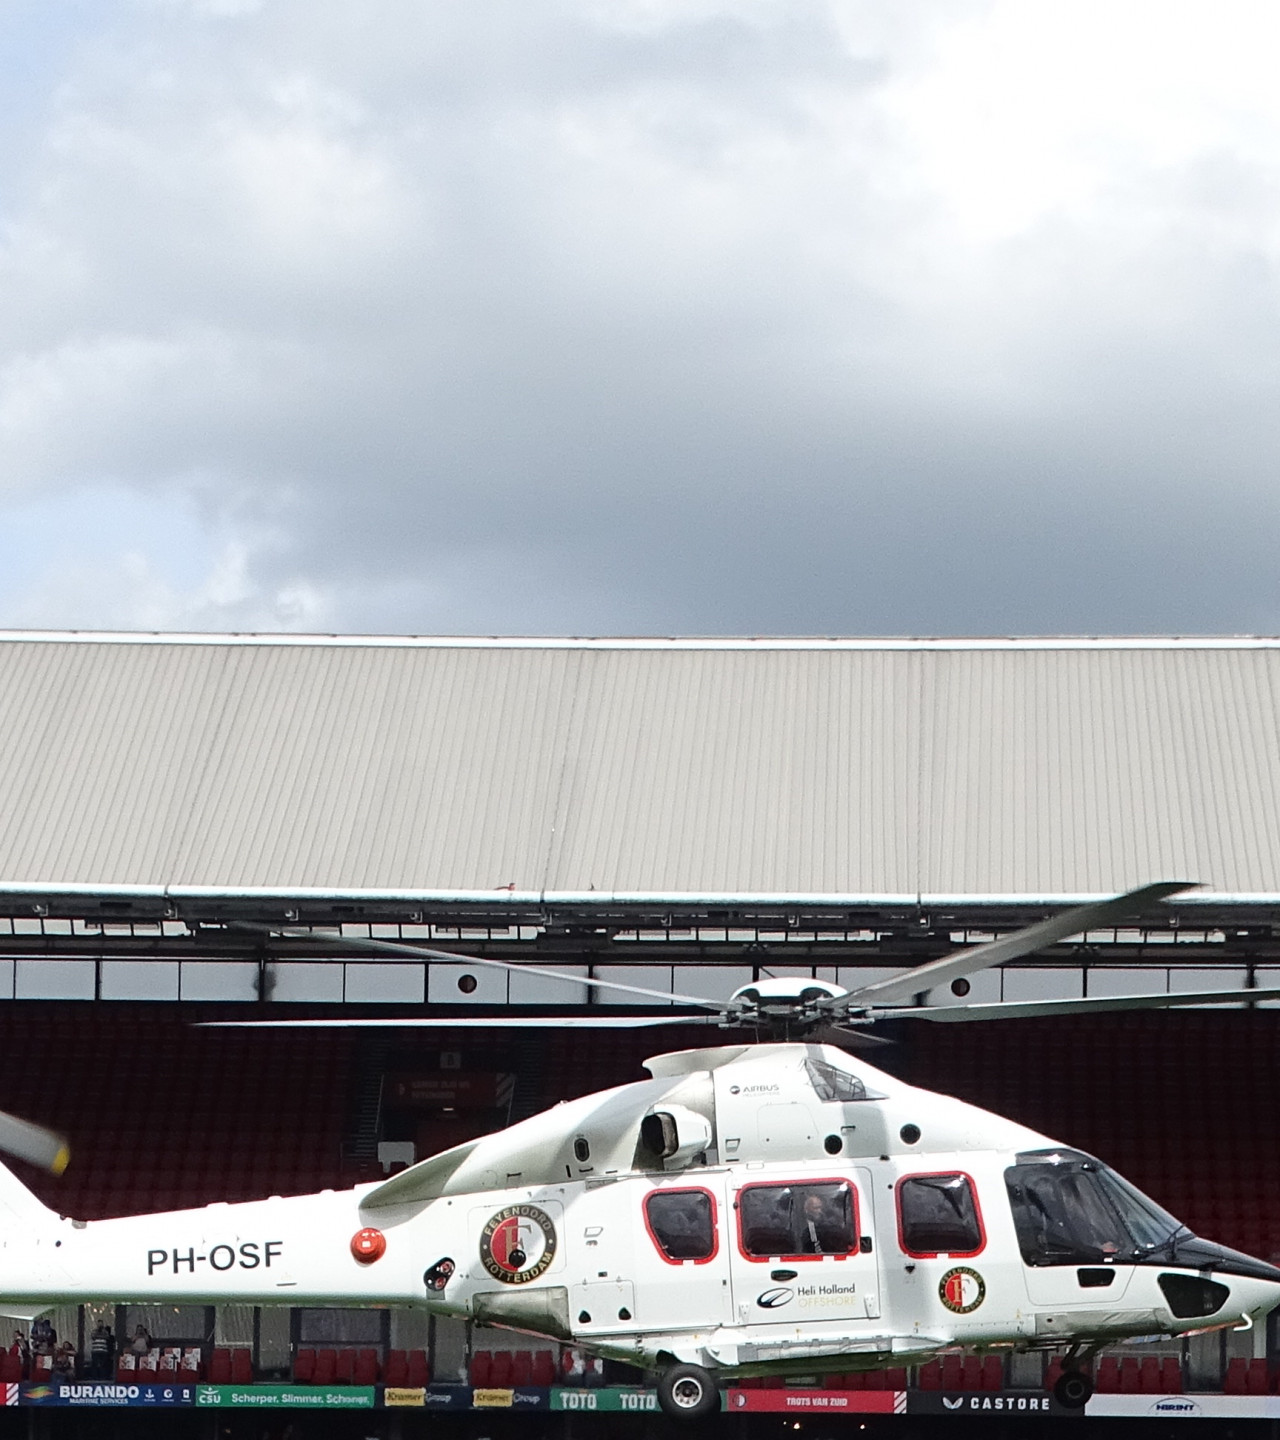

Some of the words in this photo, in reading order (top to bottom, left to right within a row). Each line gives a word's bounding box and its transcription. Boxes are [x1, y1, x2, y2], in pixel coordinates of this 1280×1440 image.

[743, 1084, 779, 1093] AIRBUS
[484, 1206, 552, 1237] FEYENOORD
[147, 1240, 283, 1276] PH-OSF
[484, 1252, 553, 1283] ROTTERDAM
[797, 1286, 815, 1297] Heli
[819, 1283, 856, 1296] Holland
[798, 1296, 856, 1308] OFFSHORE
[59, 1386, 139, 1398] BURANDO
[231, 1393, 280, 1404] Scherper.
[282, 1393, 324, 1404] Slimmer.
[199, 1394, 221, 1404] CSU
[560, 1392, 597, 1409] TOTO
[620, 1393, 657, 1409] TOTO
[786, 1397, 811, 1407] TROTS
[812, 1397, 828, 1407] VAN
[829, 1397, 848, 1407] ZUID
[970, 1398, 1050, 1411] CASTORE
